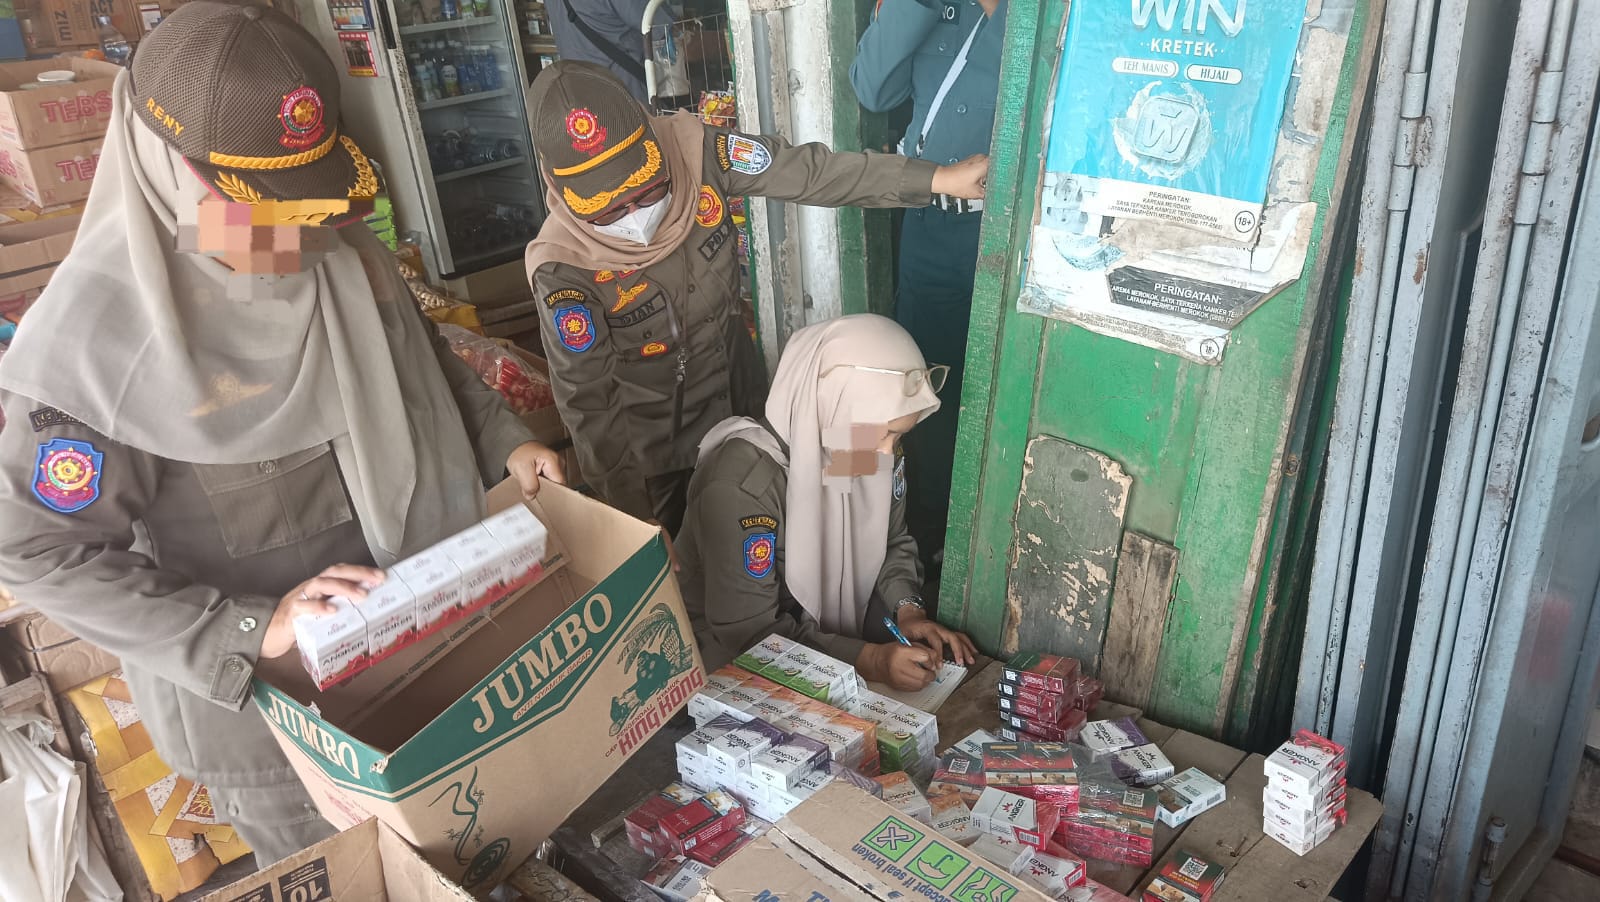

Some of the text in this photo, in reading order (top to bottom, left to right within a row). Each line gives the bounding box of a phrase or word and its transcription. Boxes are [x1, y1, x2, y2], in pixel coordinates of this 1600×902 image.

[1150, 38, 1216, 58] KRETEK
[1122, 59, 1169, 74] TEH MANIS
[1200, 68, 1229, 81] HIJAU
[146, 97, 184, 136] RENY
[1237, 216, 1252, 227] 18+
[1111, 285, 1131, 295] ARENA
[1203, 303, 1227, 316] KANKER
[1154, 283, 1222, 305] PERINGATAN:
[622, 302, 656, 326] DIAN
[1180, 304, 1209, 319] MEROKOK
[373, 615, 413, 639] ANGKER
[322, 640, 364, 666] ANGKER
[471, 593, 612, 734] JUMBO
[516, 700, 533, 719] ANTI
[534, 672, 565, 701] NYAMUK
[604, 666, 704, 758] CAP KING KONG
[861, 702, 889, 715] ANGKER
[890, 713, 921, 730] ANGKER
[267, 692, 360, 780] JUMBO
[770, 748, 801, 763] ANGKER
[1132, 749, 1152, 769] ANGKER
[1282, 747, 1321, 767] ANGKER
[1007, 798, 1026, 822] ANGKER
[937, 815, 971, 829] ANGKER
[850, 843, 887, 870] broken
[882, 864, 907, 882] seal
[902, 877, 916, 889] if
